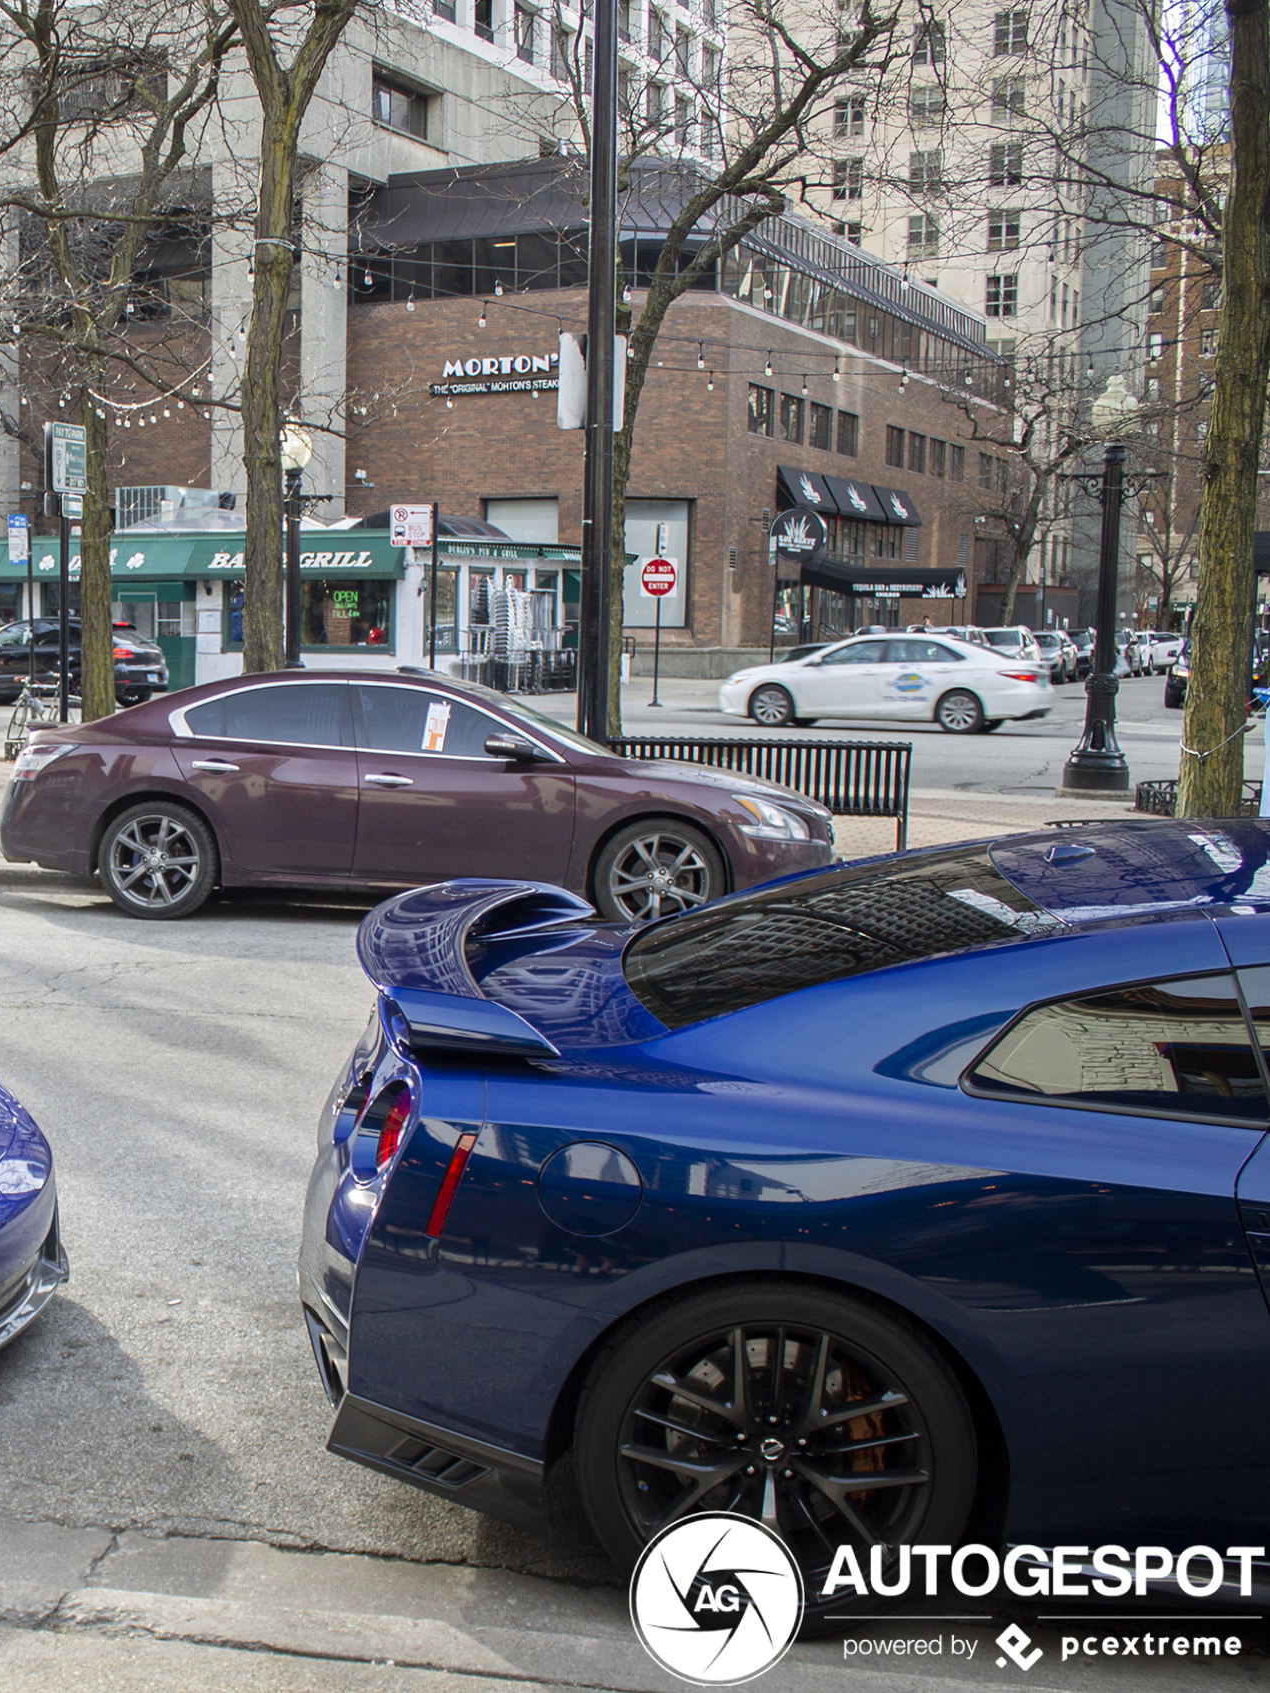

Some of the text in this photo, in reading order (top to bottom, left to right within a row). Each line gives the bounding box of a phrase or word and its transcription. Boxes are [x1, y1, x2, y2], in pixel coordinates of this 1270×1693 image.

[433, 385, 449, 394] THE
[450, 382, 490, 394] "ORIGINAL"
[491, 380, 532, 392] MORTON'S
[56, 426, 85, 440] PAY TO PARK
[408, 524, 423, 532] BUS
[408, 531, 426, 539] STOP
[299, 551, 373, 568] GRILL
[646, 565, 672, 573] DO NOT
[648, 582, 669, 590] ENTER
[333, 591, 359, 602] OPEN
